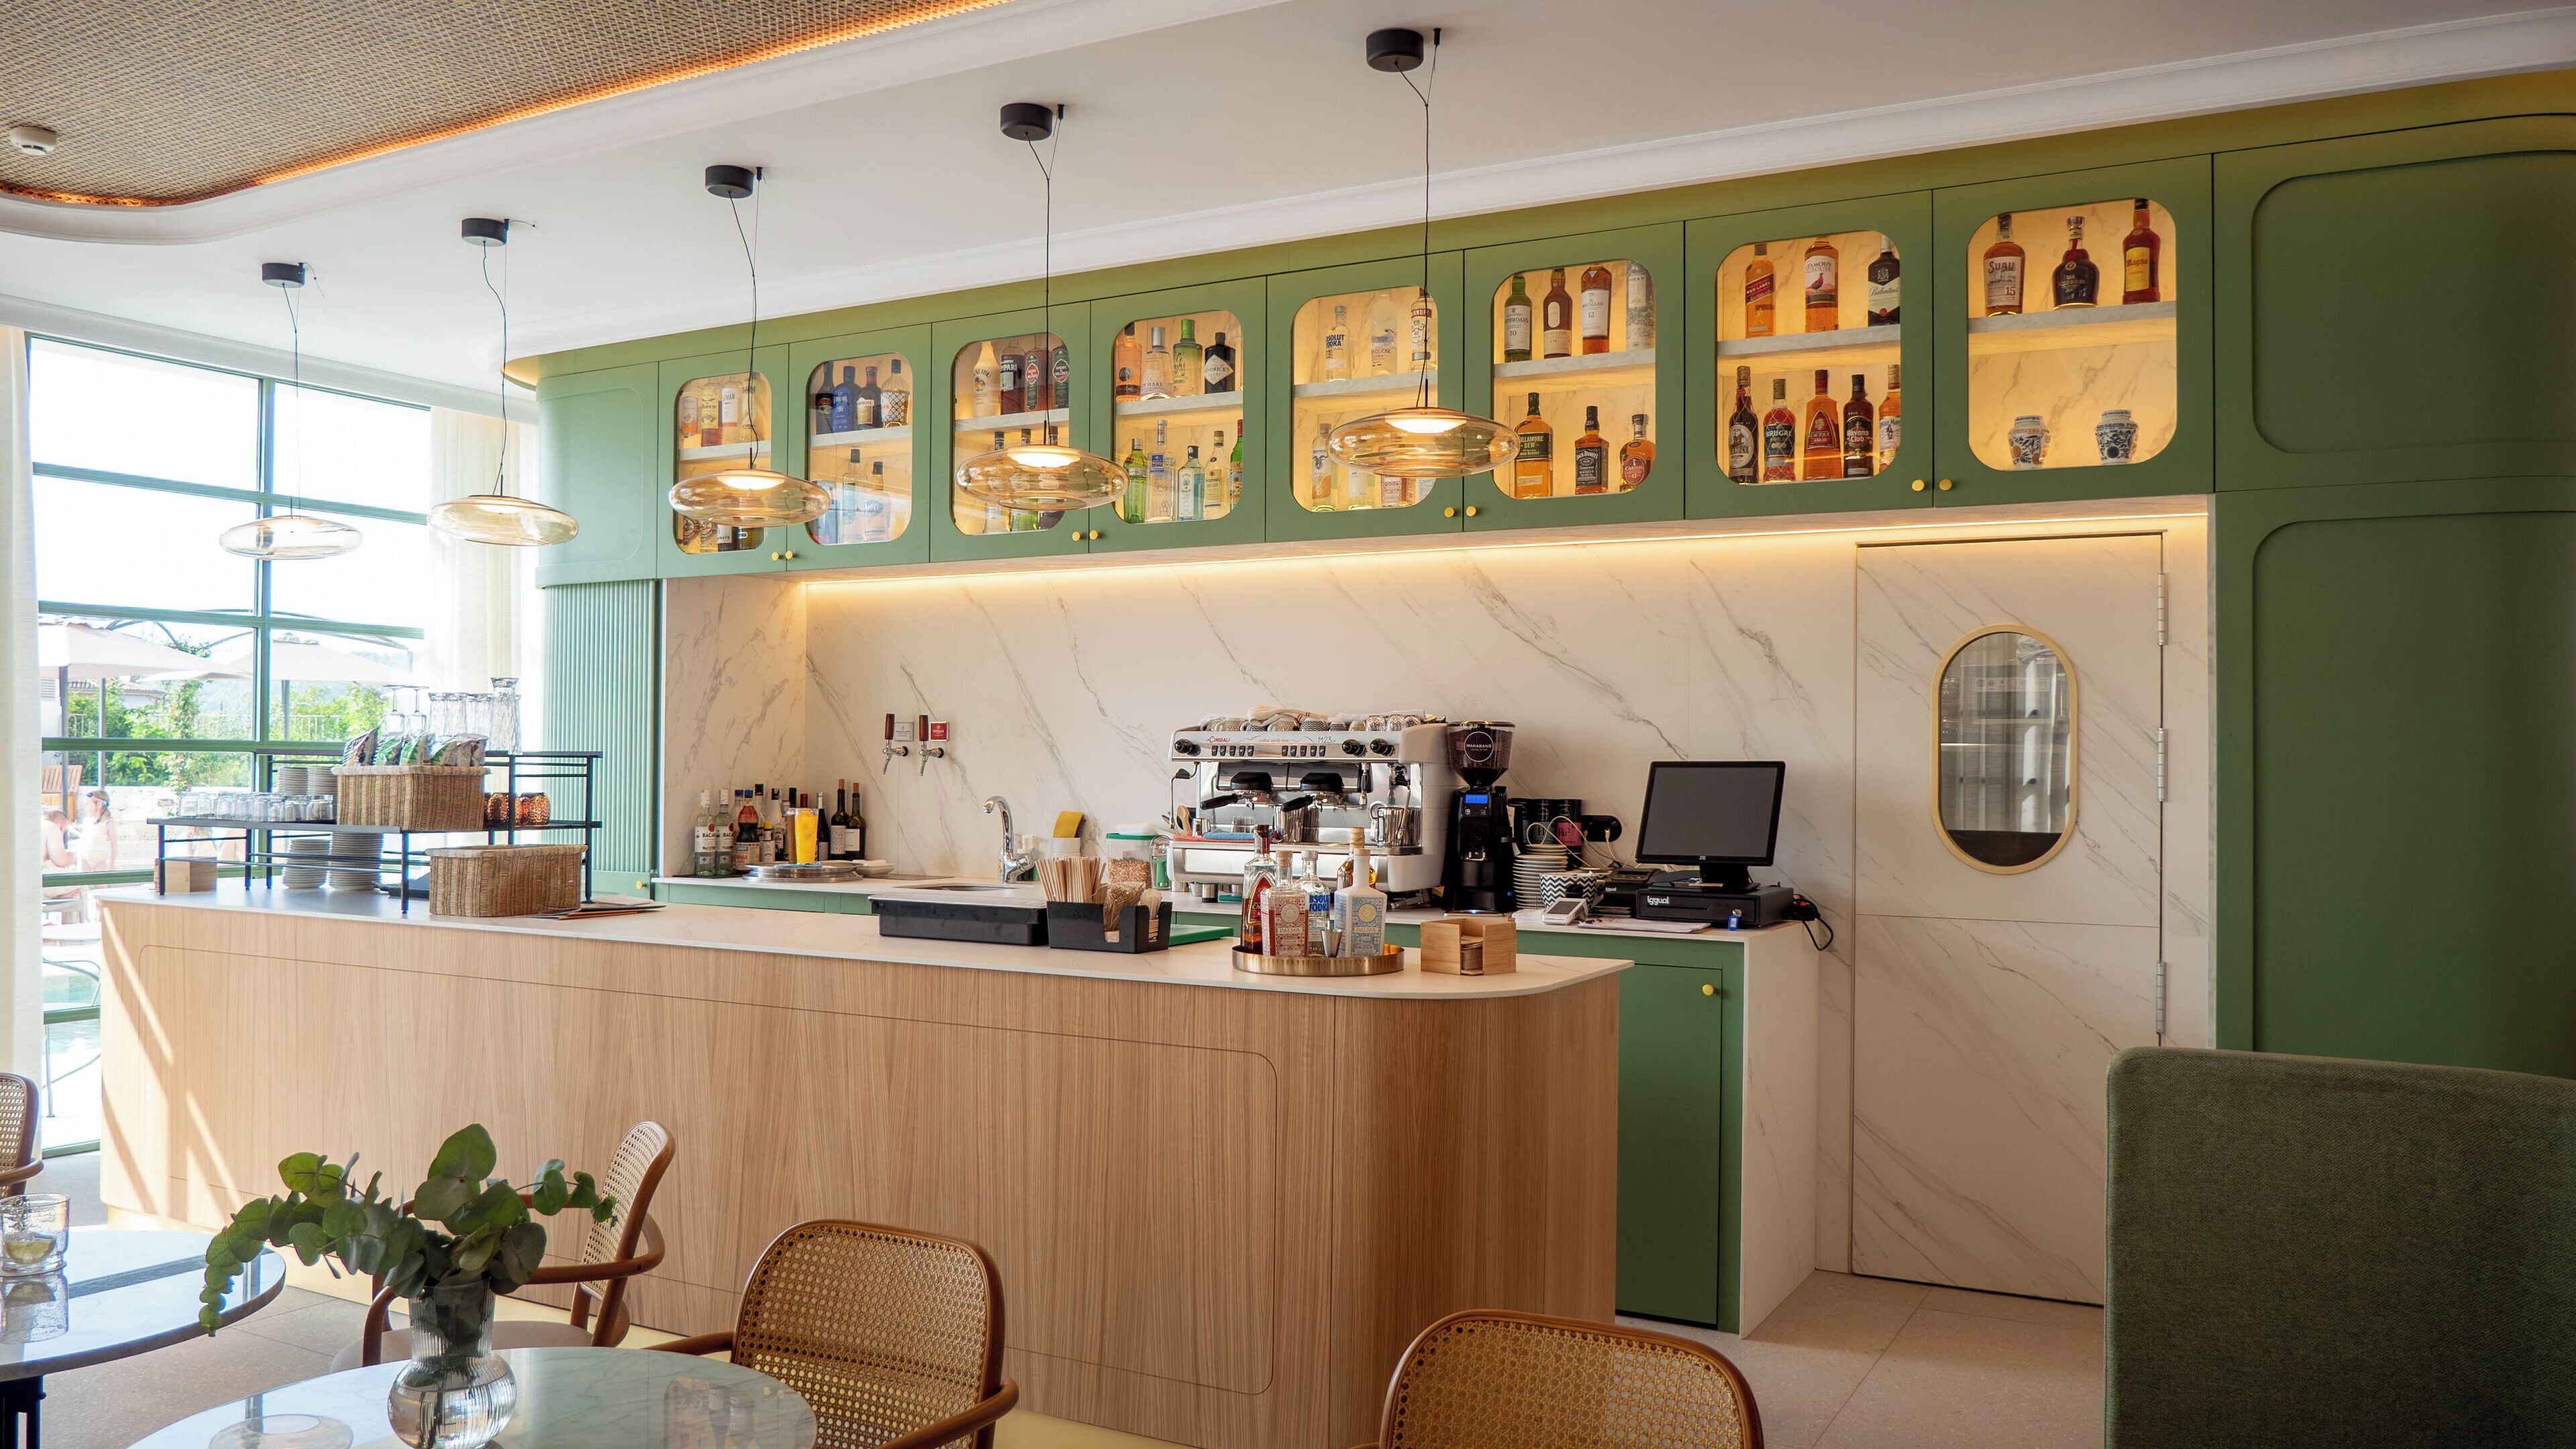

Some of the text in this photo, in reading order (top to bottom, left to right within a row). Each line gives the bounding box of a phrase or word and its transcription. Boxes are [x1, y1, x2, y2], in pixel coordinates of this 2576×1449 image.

[1988, 260, 2015, 274] SUAU
[2127, 259, 2148, 267] Magno
[1756, 281, 1771, 290] LABEL
[2004, 286, 2016, 296] 15
[1647, 896, 1670, 906] iggual
